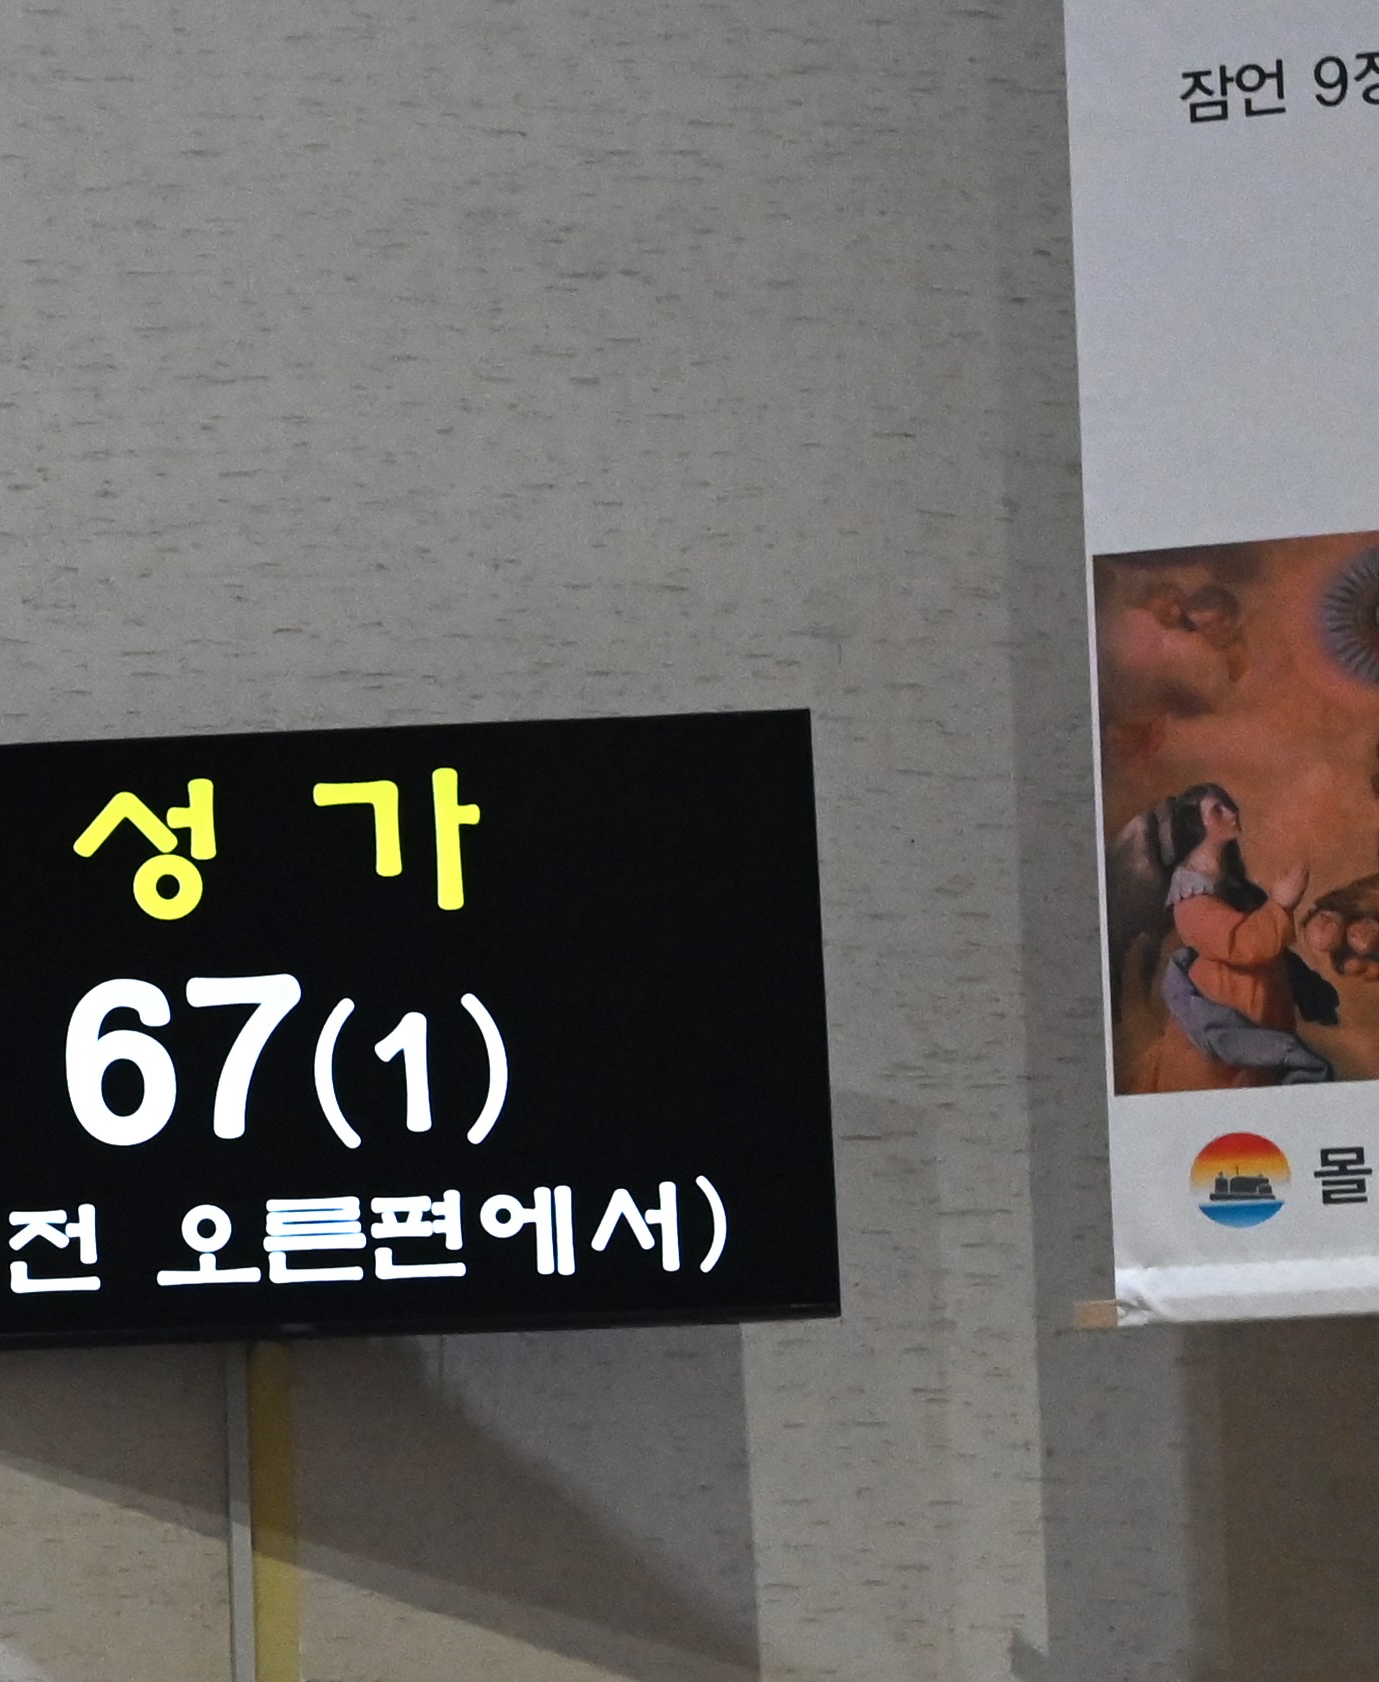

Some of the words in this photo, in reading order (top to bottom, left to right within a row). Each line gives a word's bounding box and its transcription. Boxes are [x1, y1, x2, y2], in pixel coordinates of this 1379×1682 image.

[1179, 58, 1286, 124] 잠언
[71, 776, 218, 922] 성
[311, 766, 482, 912] 가
[64, 972, 510, 1150] 67(1)
[155, 1174, 729, 1288] 오른편에서)
